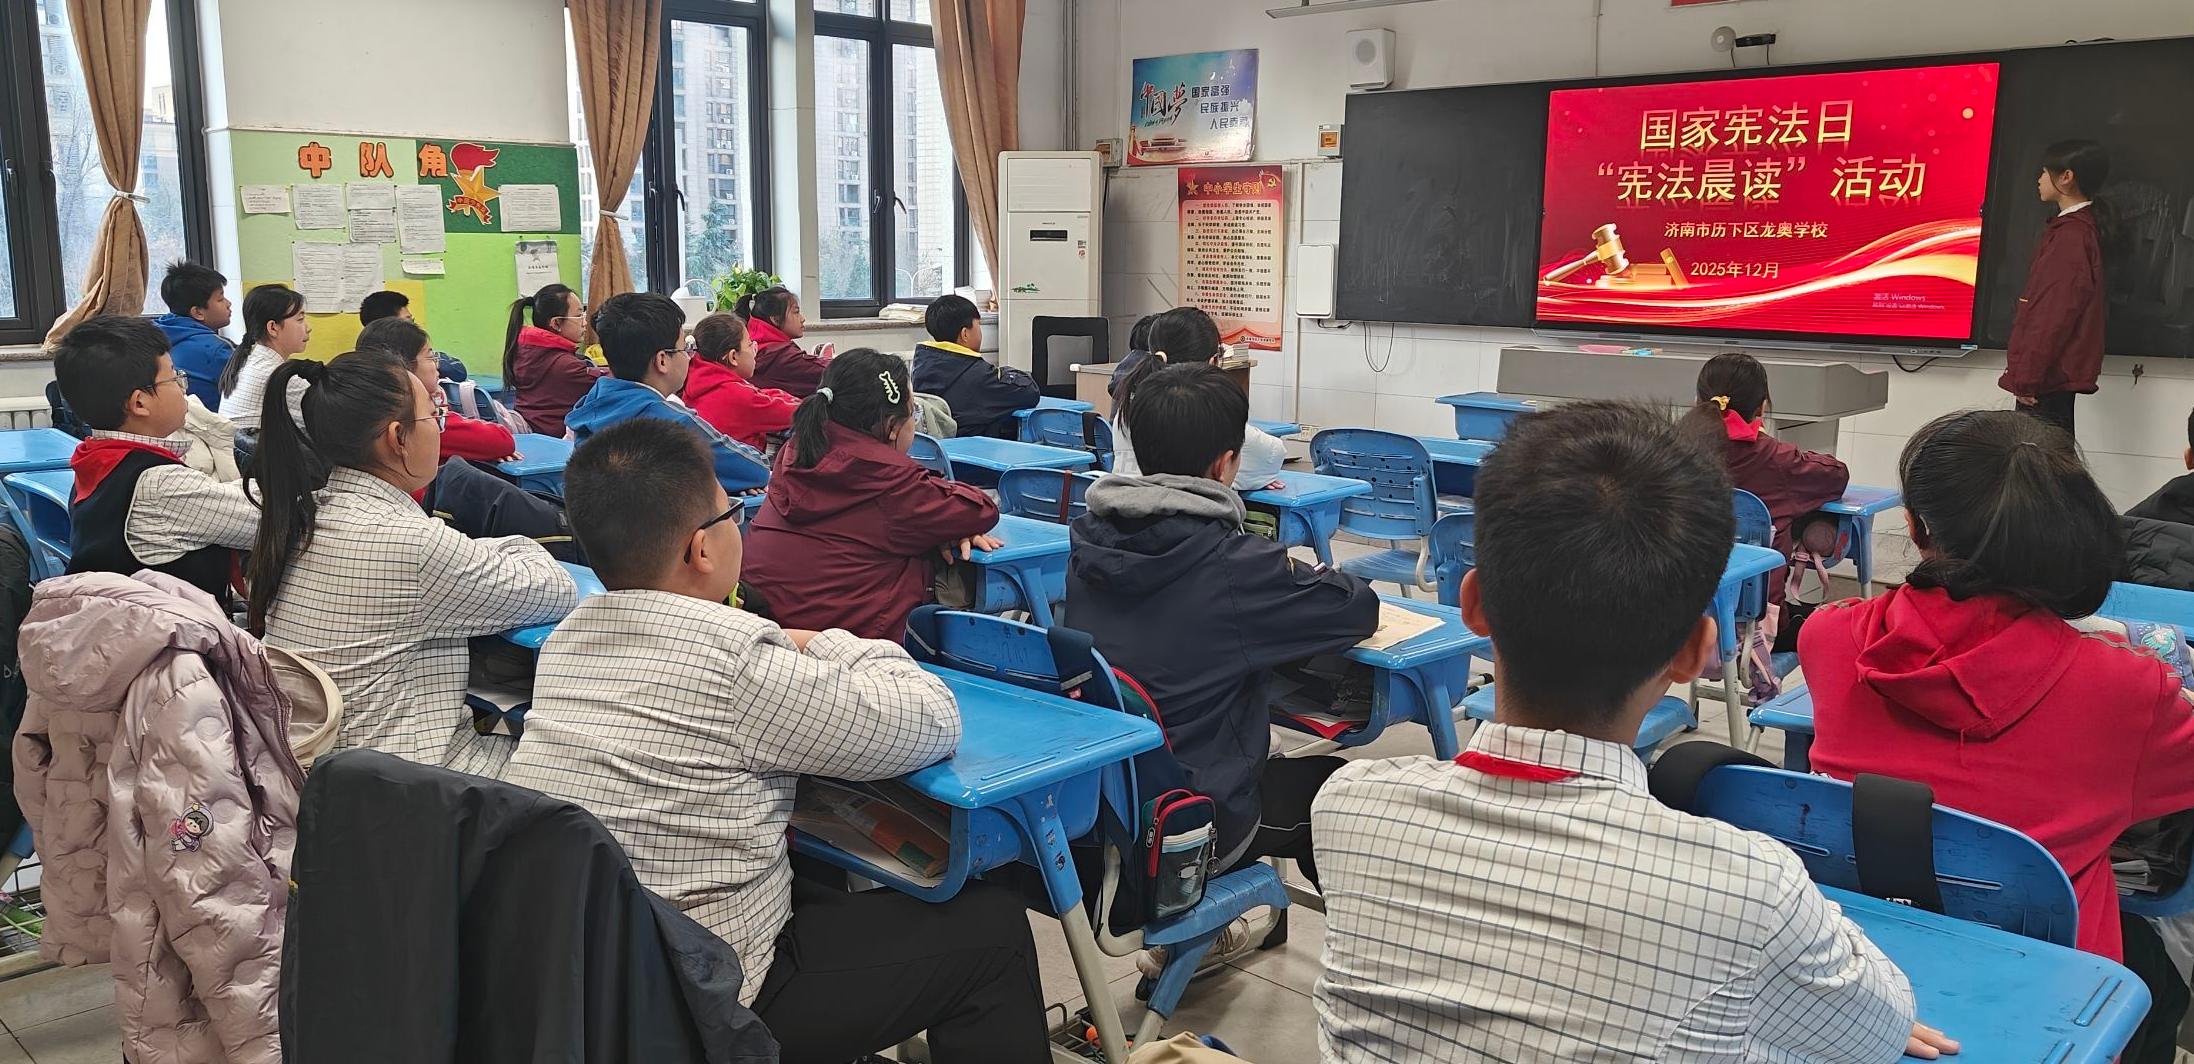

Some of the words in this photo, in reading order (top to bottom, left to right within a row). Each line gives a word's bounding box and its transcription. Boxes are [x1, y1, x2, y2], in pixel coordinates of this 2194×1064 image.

[1191, 84, 1231, 99] 国家富强
[1200, 101, 1240, 114] 民族振兴
[1640, 100, 1853, 150] 国家宪法日
[298, 141, 449, 178] 中队角
[1830, 153, 1926, 198] 活动
[1664, 221, 1828, 239] 济南市历下区龙奥学校
[1690, 260, 1780, 279] 2025年12月
[1891, 293, 1926, 302] Windows
